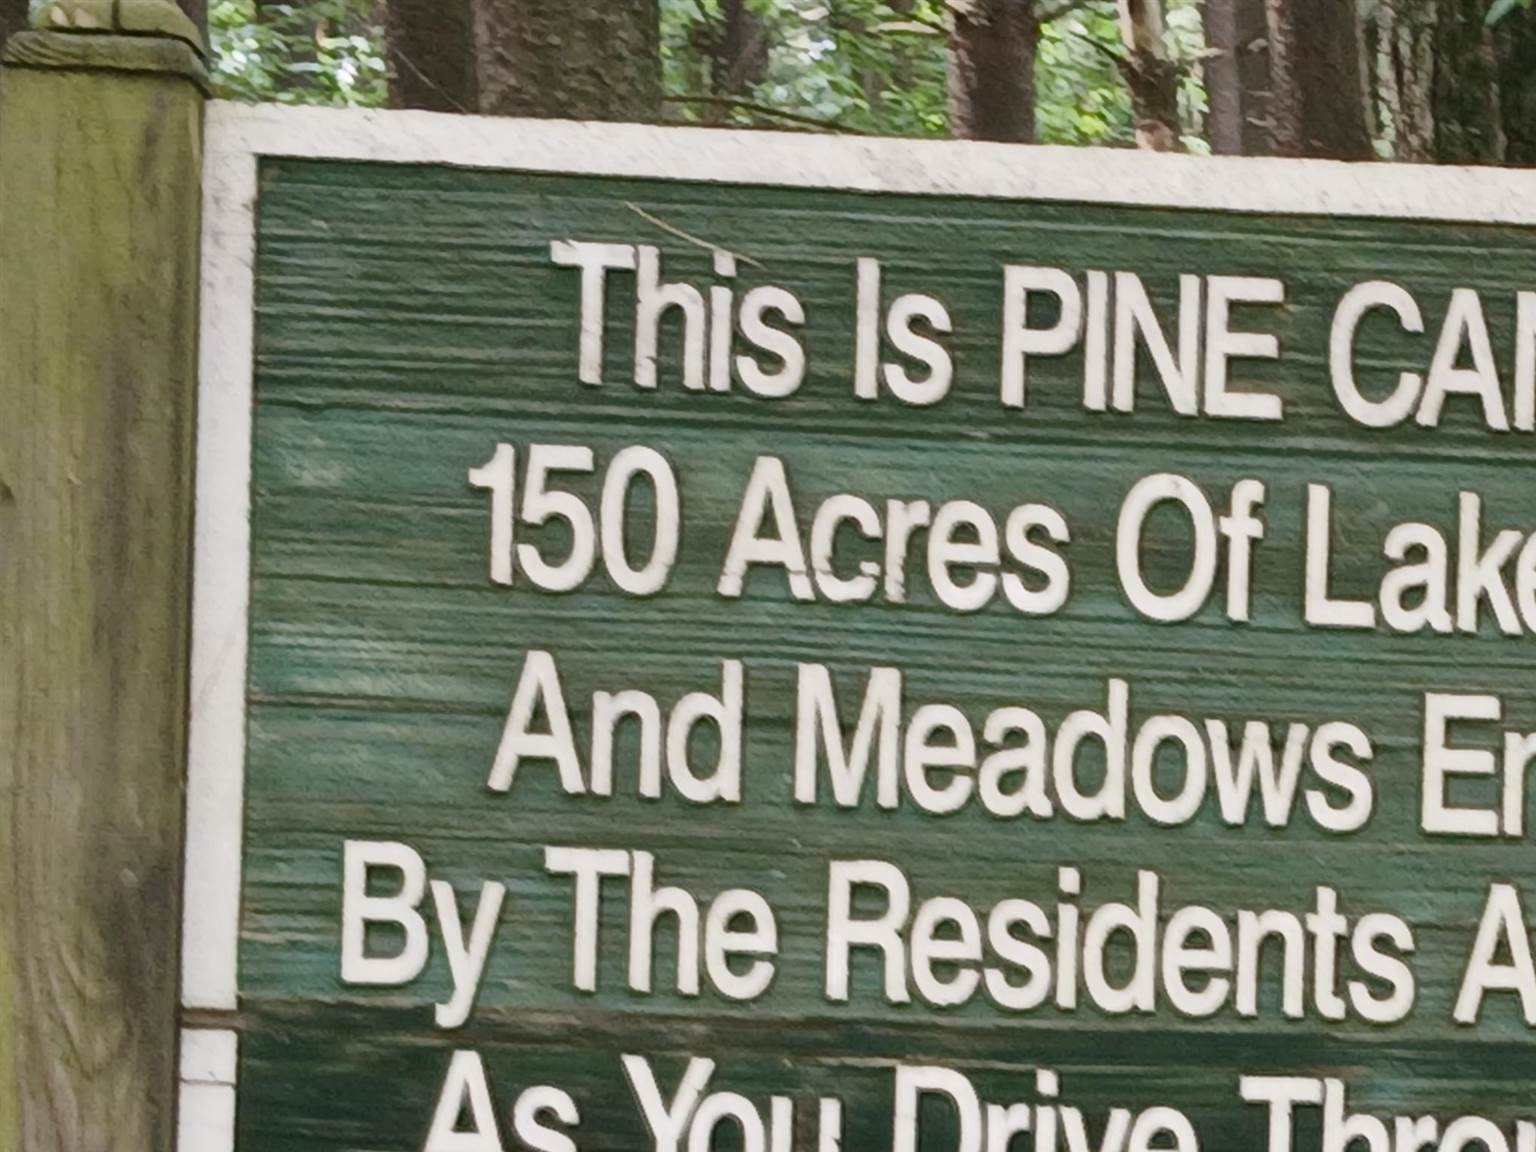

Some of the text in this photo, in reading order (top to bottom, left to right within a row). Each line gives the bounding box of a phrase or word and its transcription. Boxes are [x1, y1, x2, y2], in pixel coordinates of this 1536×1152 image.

[549, 240, 806, 398] This
[854, 256, 954, 405] Is
[1000, 264, 1285, 420] PINE
[467, 442, 680, 596] 150
[716, 455, 1071, 615] Acres
[1115, 472, 1266, 622] Of
[486, 649, 744, 803] And
[794, 661, 1374, 832] Meadows
[340, 838, 507, 1029] By
[543, 844, 779, 1000] The
[825, 858, 1416, 1023] Residents
